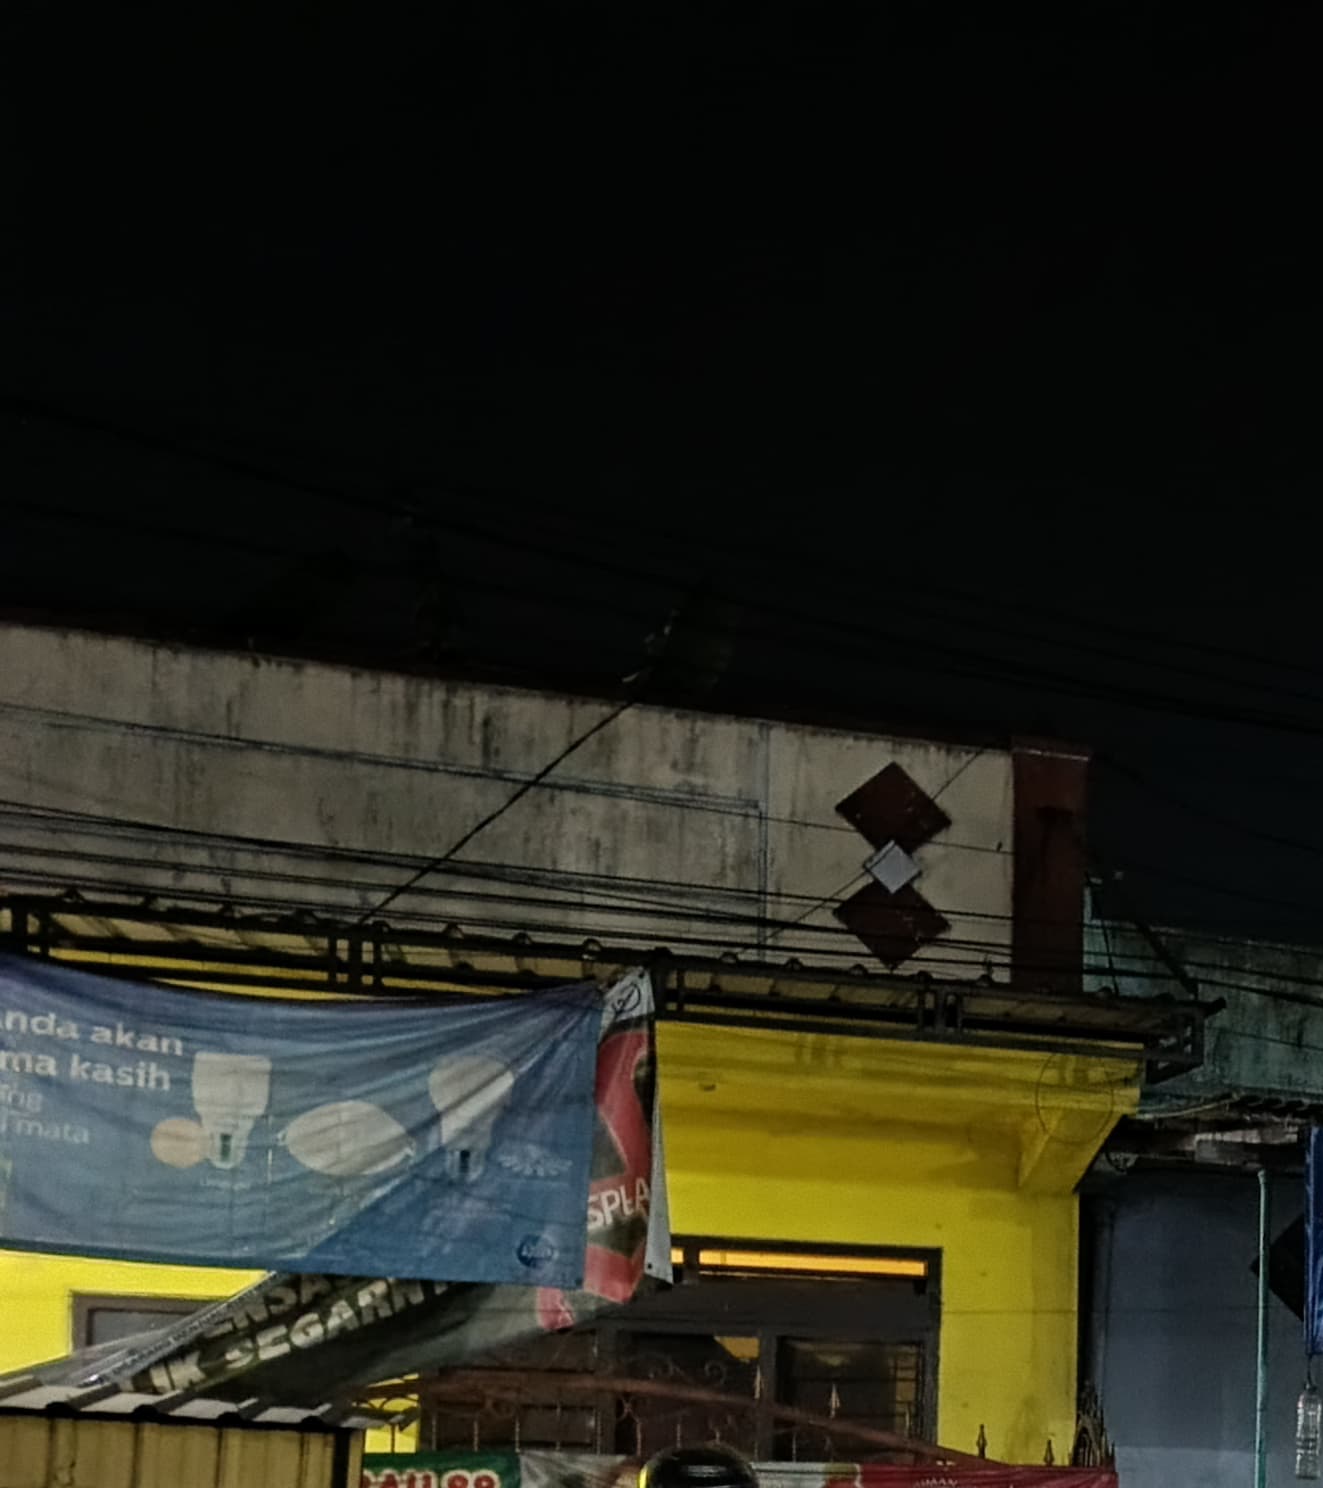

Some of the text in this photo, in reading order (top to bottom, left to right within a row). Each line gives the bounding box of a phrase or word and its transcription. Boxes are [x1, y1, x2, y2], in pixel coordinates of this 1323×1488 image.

[0, 1009, 184, 1057] nda akan
[69, 1053, 171, 1091] kasih
